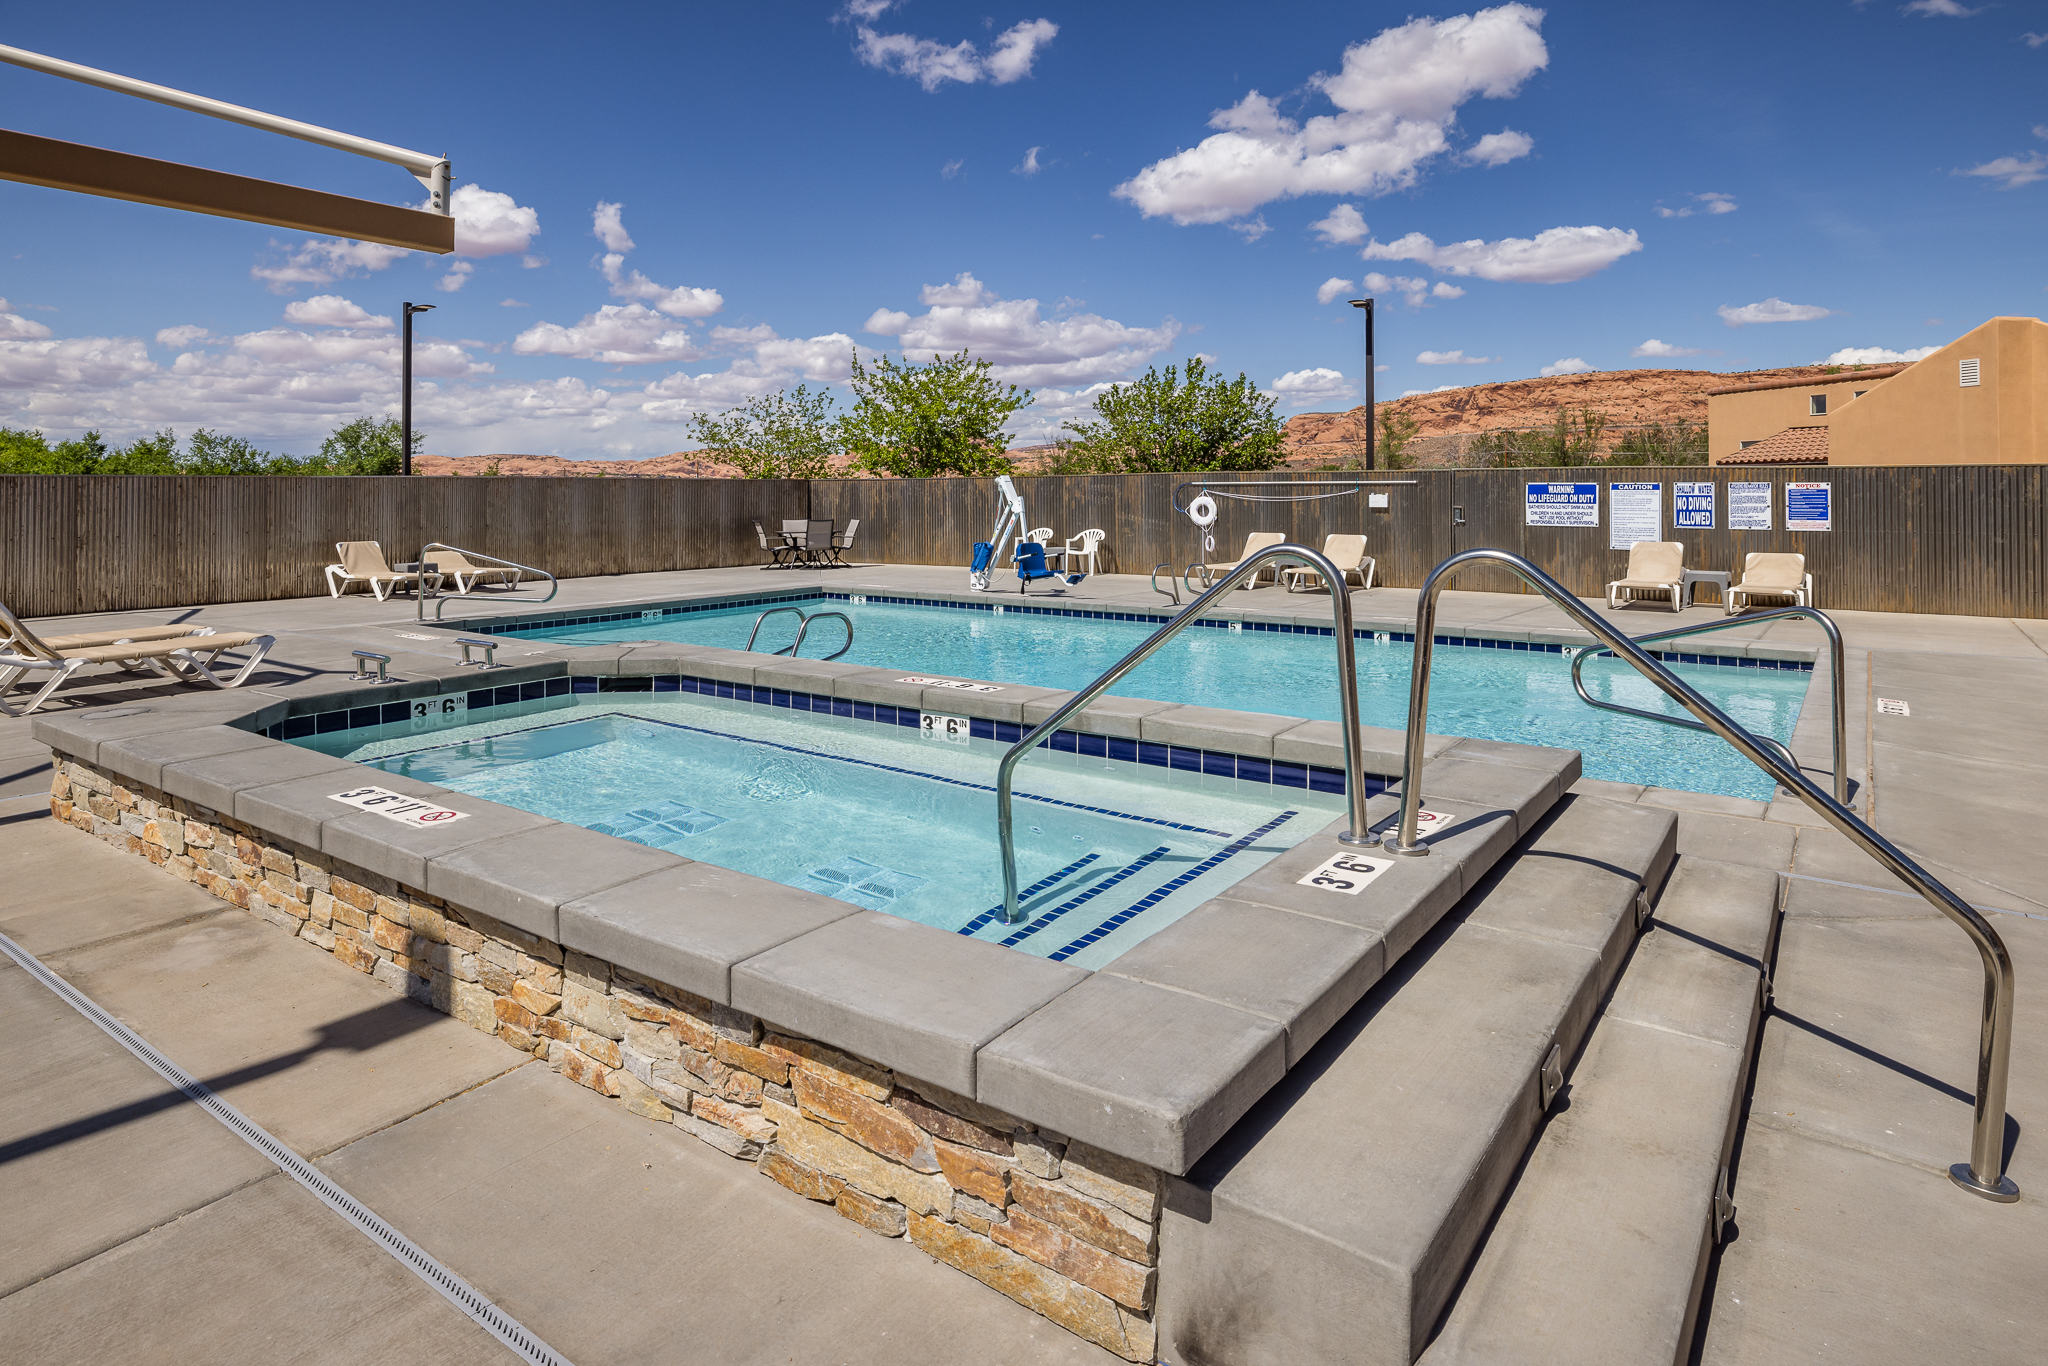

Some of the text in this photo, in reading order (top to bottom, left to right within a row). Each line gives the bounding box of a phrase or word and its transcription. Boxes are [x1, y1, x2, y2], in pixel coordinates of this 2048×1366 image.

[1548, 485, 1574, 493] WARNING
[1676, 485, 1712, 494] SHALLOW WATER
[1528, 494, 1594, 502] NO LIFEGUARD ON DUTY
[1677, 497, 1712, 510] NO DIVING
[1679, 512, 1711, 525] ALLOWED
[414, 703, 427, 717] 3
[442, 698, 455, 713] 6
[456, 696, 465, 704] IN
[923, 715, 934, 729] 3
[946, 718, 958, 733] 6
[340, 789, 376, 798] 3
[362, 796, 399, 805] 6
[1312, 877, 1354, 889] 3
[1333, 861, 1375, 873] 6
